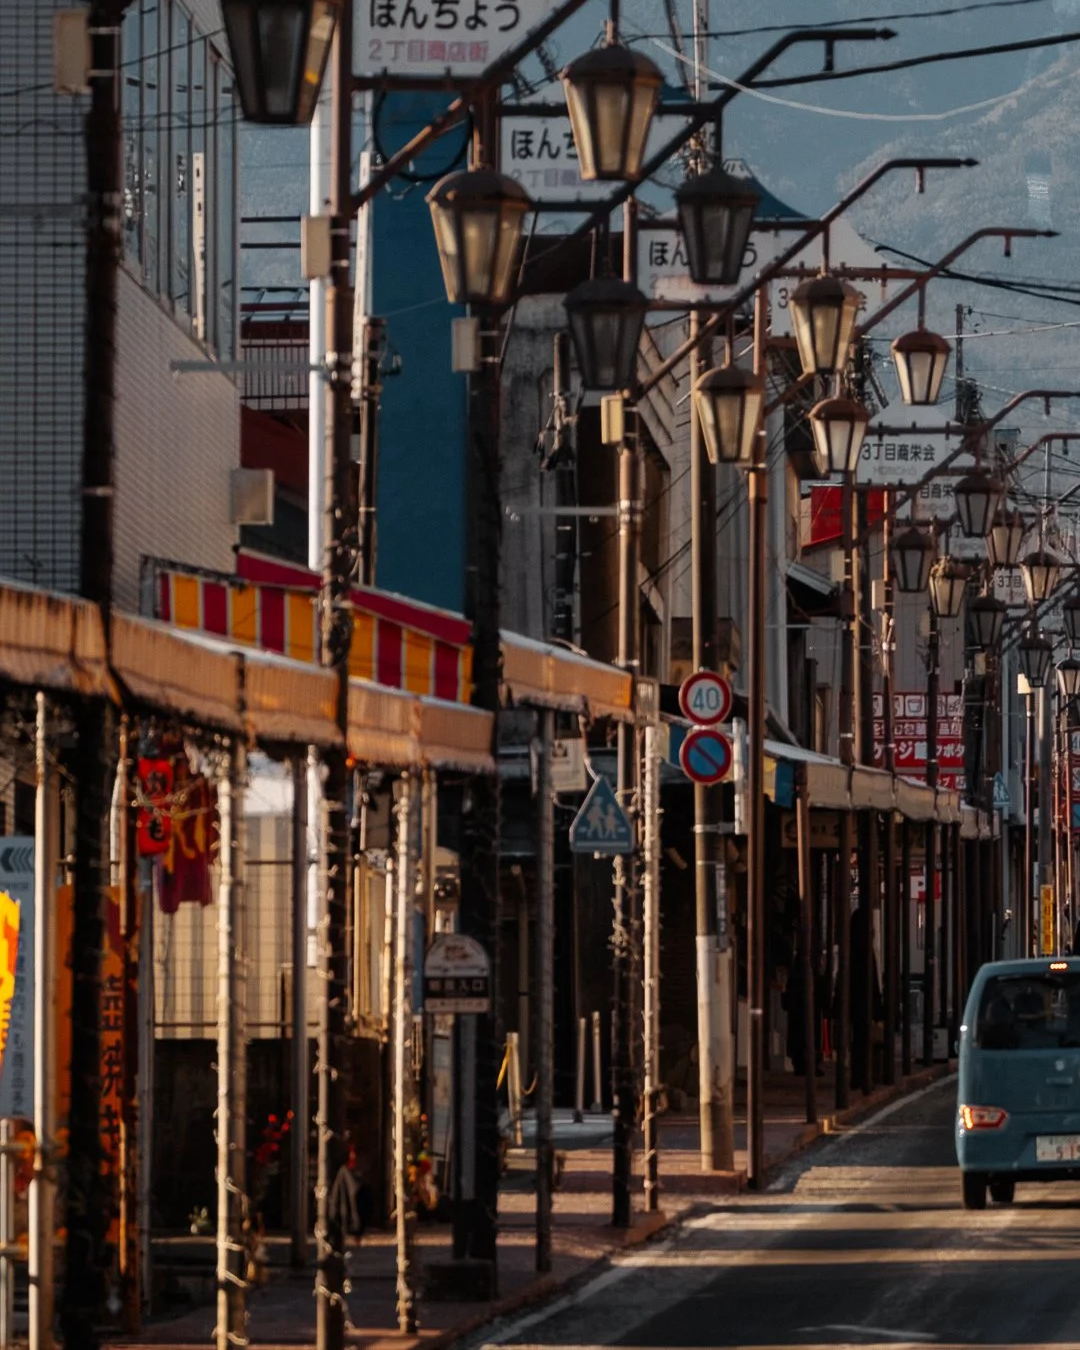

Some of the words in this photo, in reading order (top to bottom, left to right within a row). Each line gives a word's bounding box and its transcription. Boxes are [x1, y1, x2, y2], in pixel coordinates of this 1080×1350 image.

[861, 442, 935, 462] 3丁目商栄会
[693, 686, 720, 711] 40
